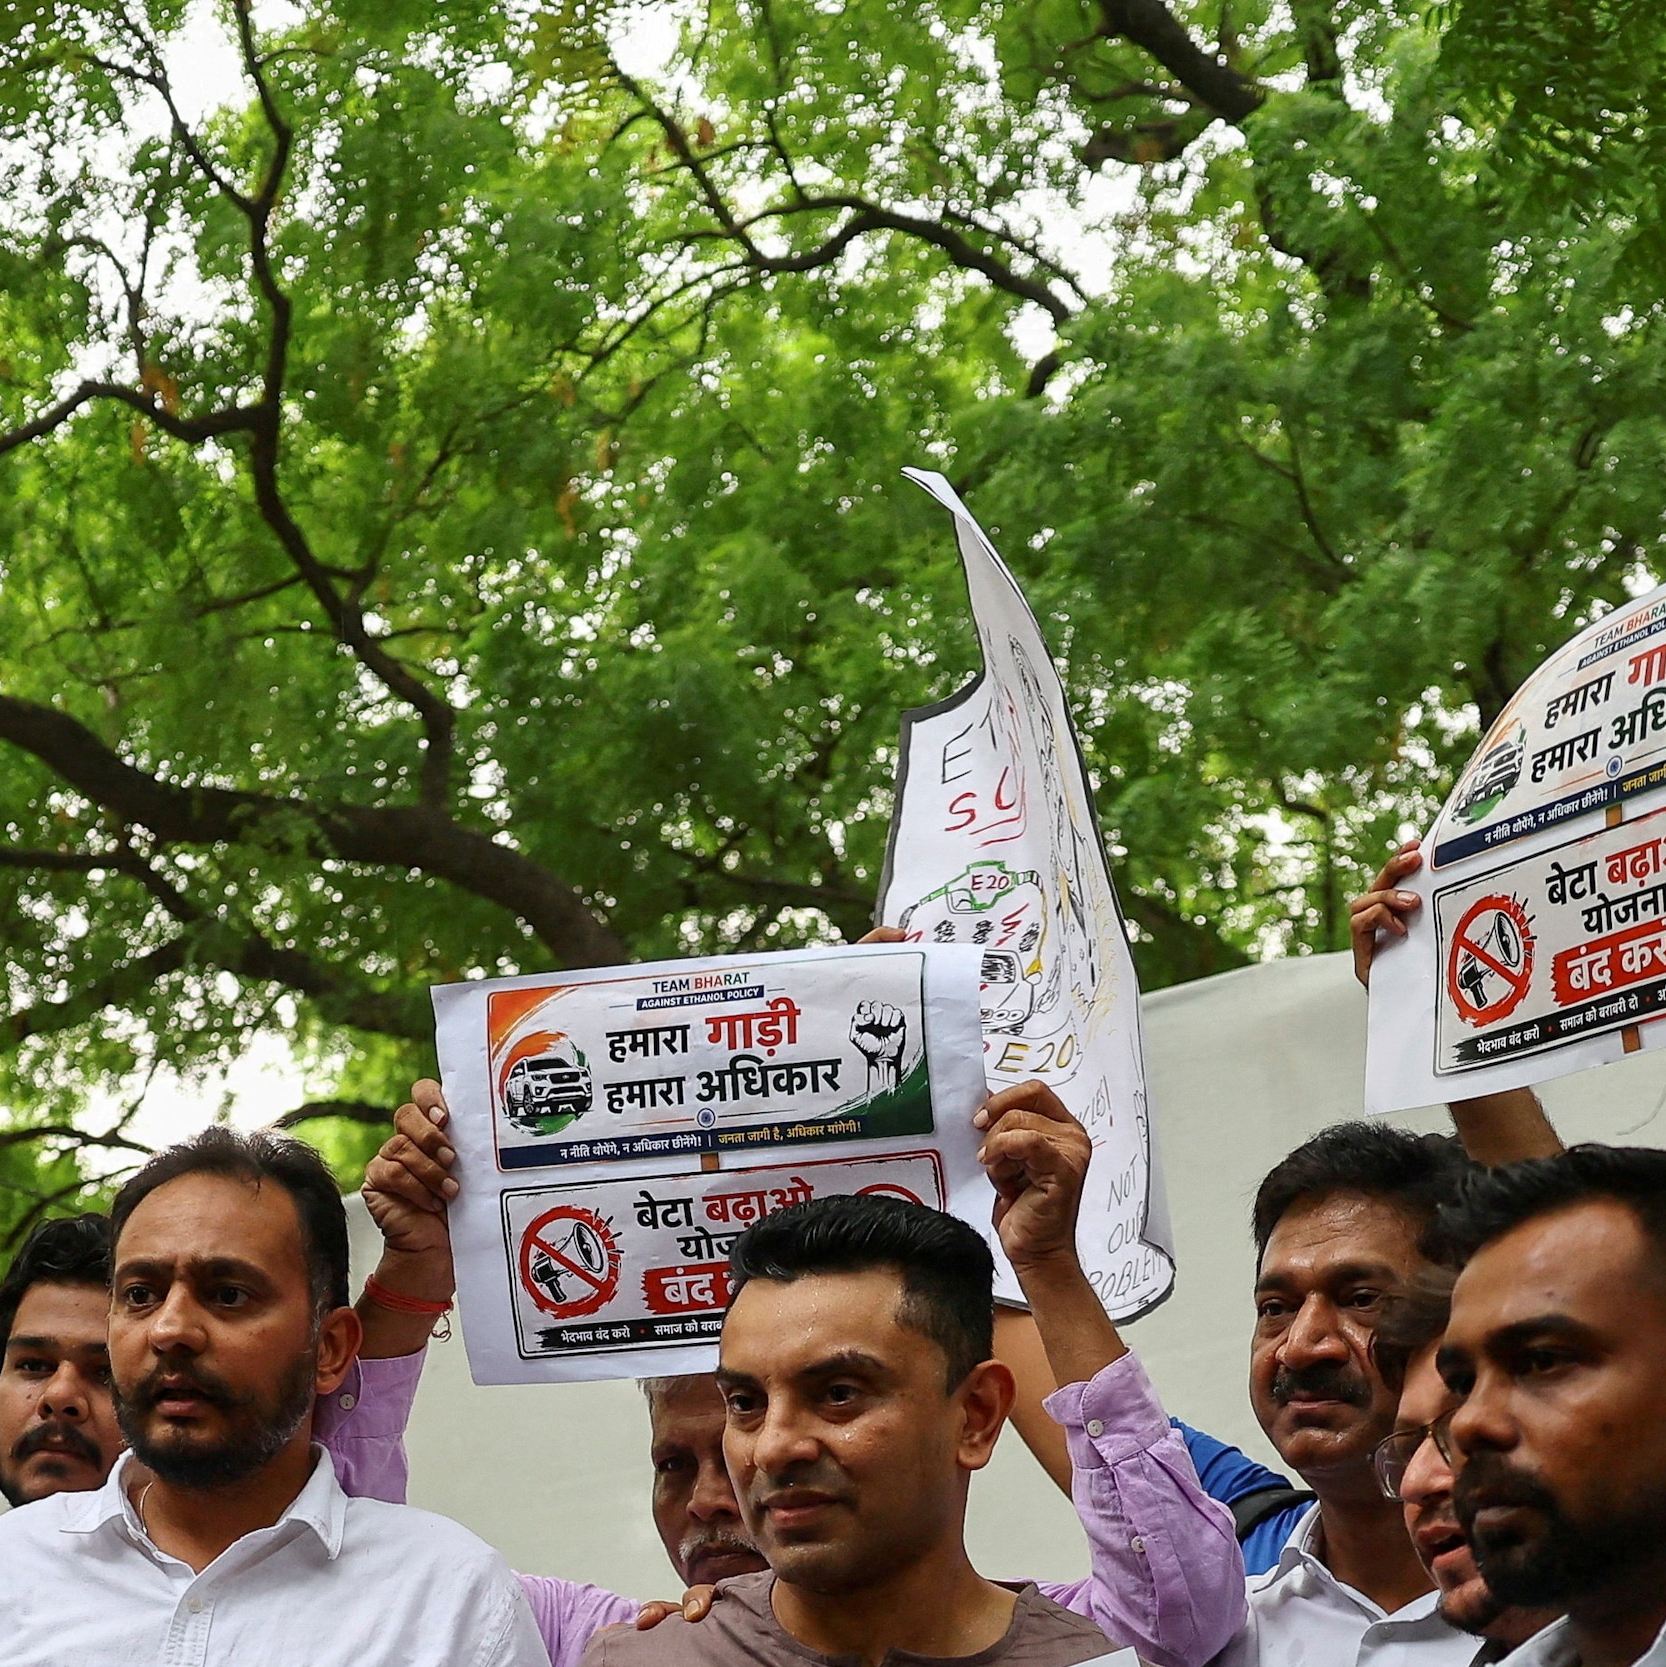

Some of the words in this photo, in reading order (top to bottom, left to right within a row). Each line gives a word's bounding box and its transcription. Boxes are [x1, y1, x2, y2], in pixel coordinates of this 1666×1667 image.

[1581, 644, 1613, 667] AGAINST
[1614, 628, 1649, 650] ETHANOL
[1592, 623, 1623, 648] TEAM
[1544, 670, 1616, 729] हमारा
[1531, 725, 1602, 783] हमारा
[1484, 832, 1491, 842] न
[1492, 823, 1510, 839] नीति
[1538, 812, 1545, 823] न
[1546, 799, 1580, 820] अधिकार
[971, 874, 1010, 891] E20
[1545, 860, 1597, 905] बेटा
[651, 978, 689, 993] TEAM
[693, 971, 749, 989] BHARAT
[1566, 945, 1612, 990] बंद
[641, 996, 681, 1008] AGAINST
[683, 992, 725, 1004] ETHANOL
[727, 988, 758, 998] POLICY
[605, 1023, 691, 1062] हमारा
[706, 997, 800, 1055] गाड़ी
[994, 1032, 1075, 1073] E20
[602, 1075, 685, 1114] हमारा
[695, 1053, 842, 1101] अधिकार
[559, 1148, 567, 1158] न
[569, 1143, 590, 1157] नीति
[621, 1143, 630, 1152] न
[632, 1138, 669, 1151] अधिकार
[717, 1132, 744, 1143] जनता
[746, 1126, 770, 1140] जागी
[786, 1123, 824, 1137] अधिकार
[1107, 1153, 1138, 1212] NOT
[632, 1190, 693, 1229] बेटा
[660, 1267, 715, 1305] बंद
